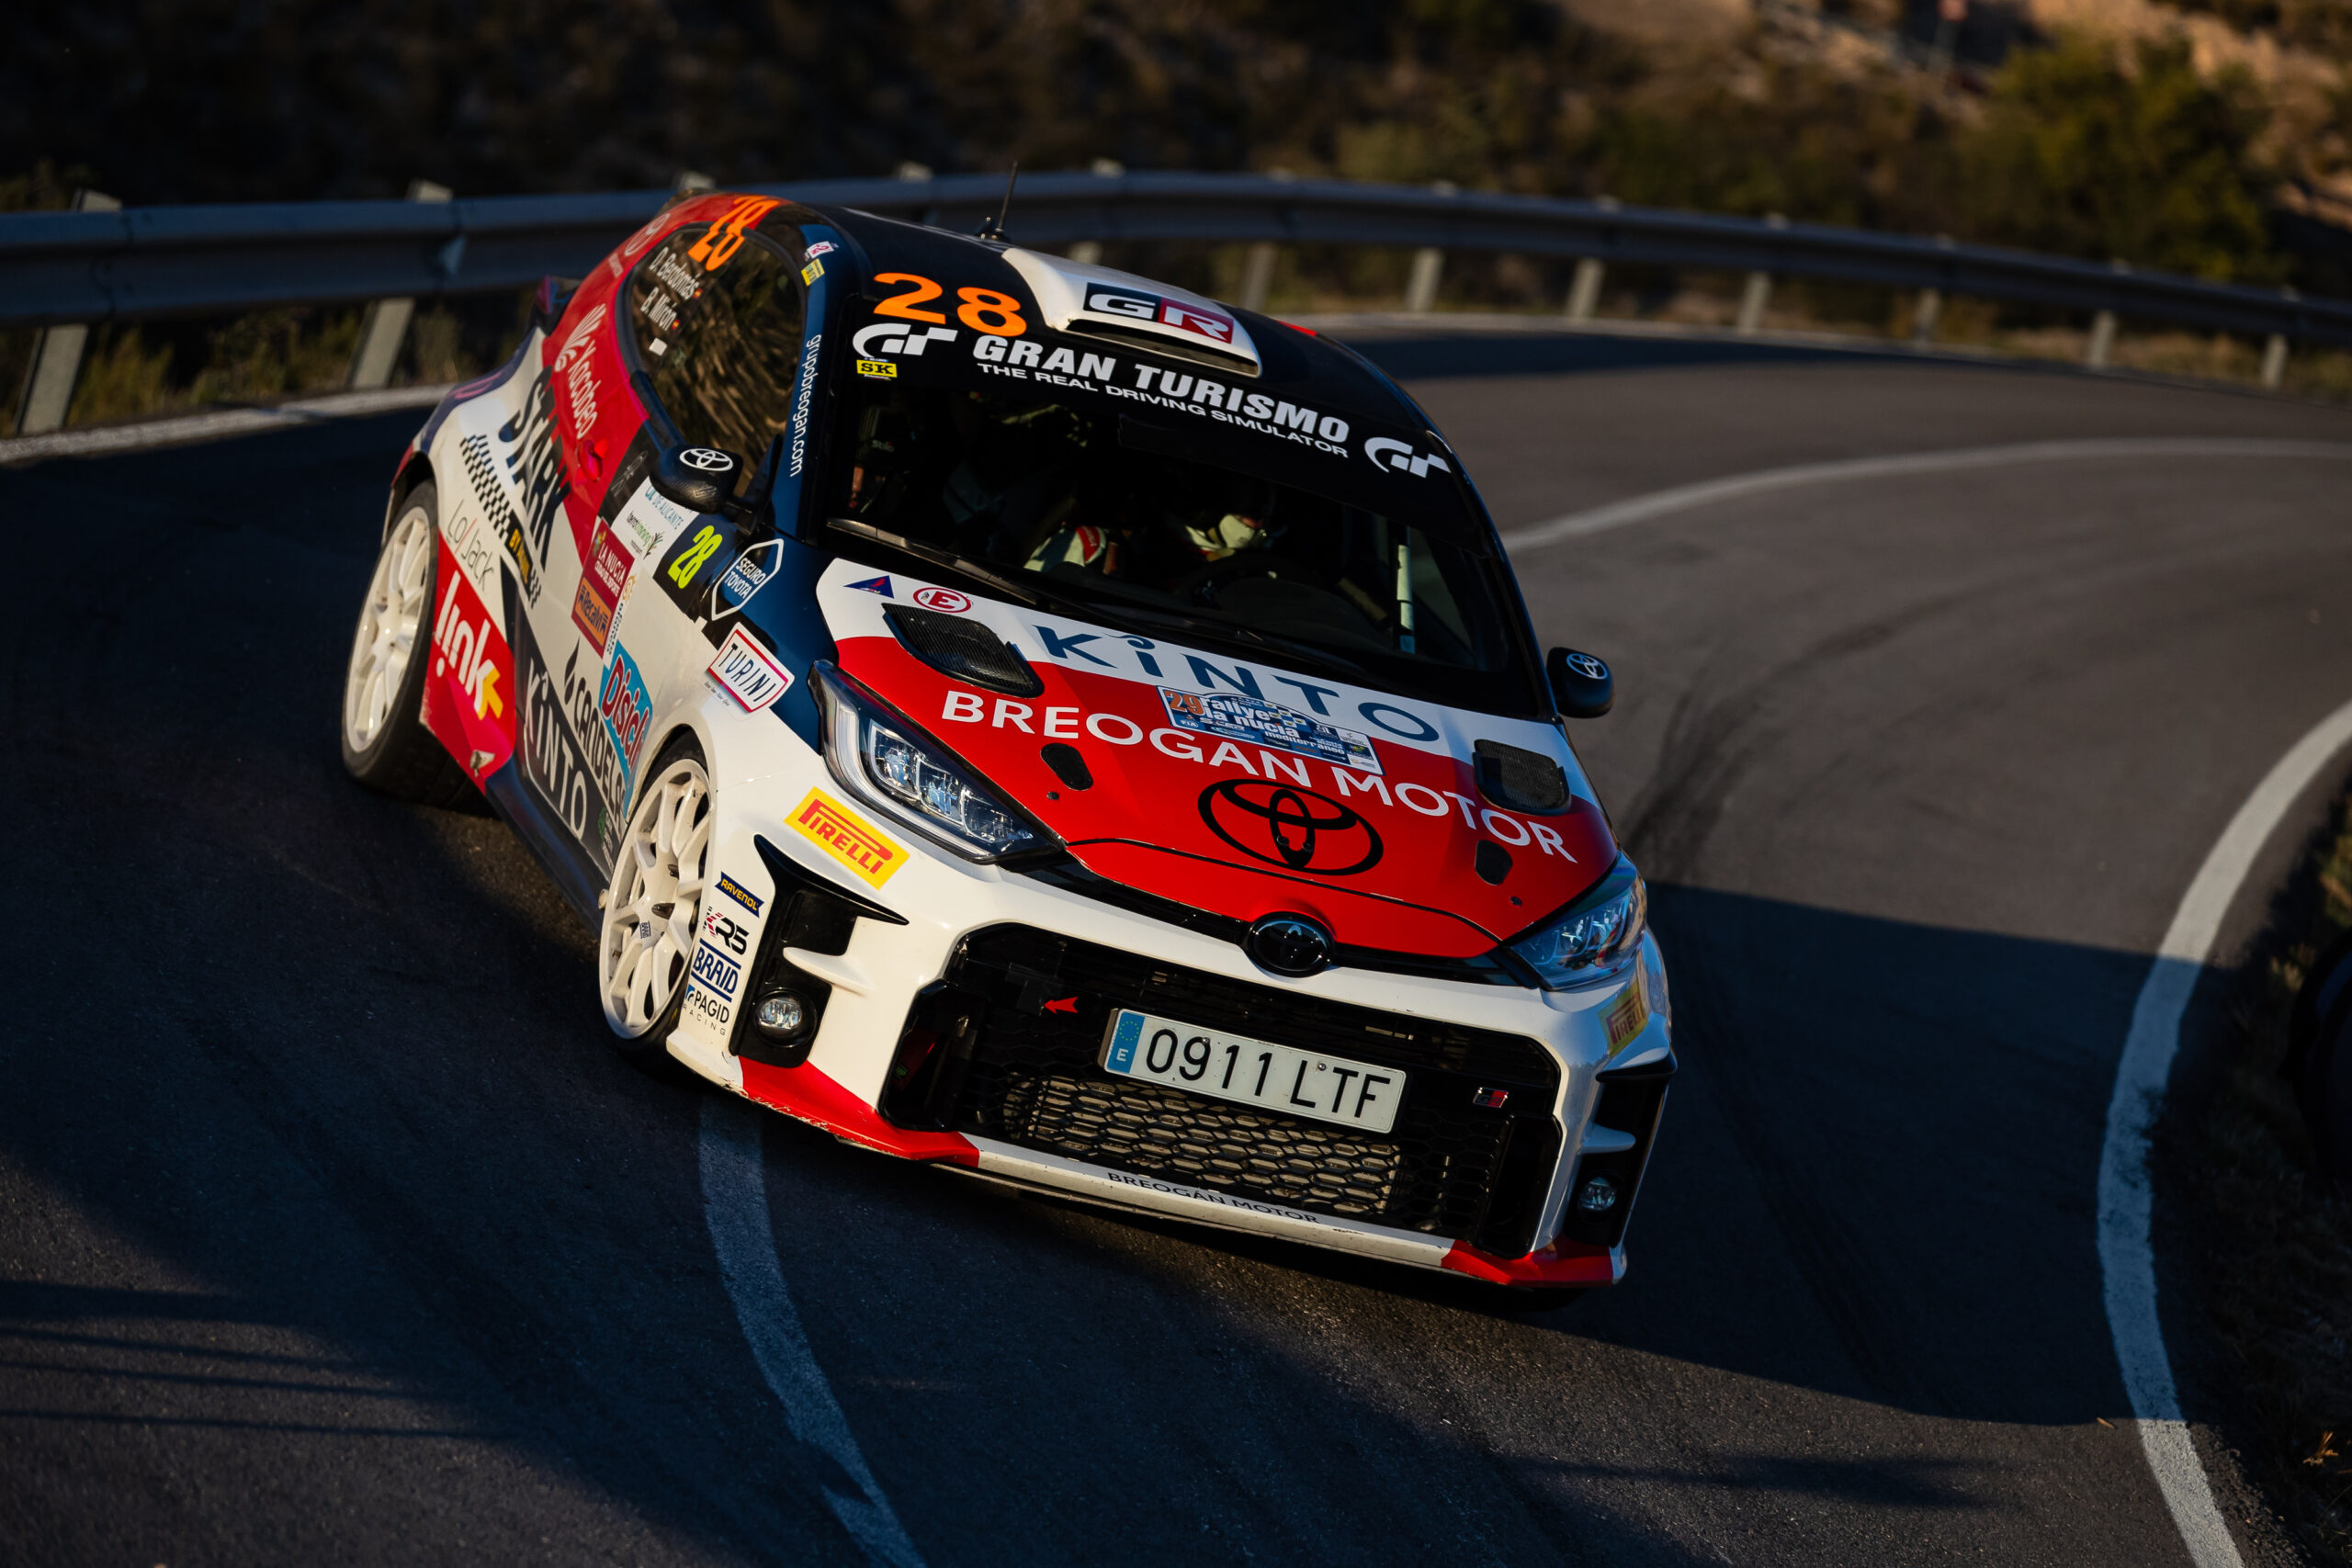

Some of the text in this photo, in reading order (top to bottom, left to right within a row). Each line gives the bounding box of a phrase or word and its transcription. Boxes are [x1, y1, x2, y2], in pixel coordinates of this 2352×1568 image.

[687, 195, 780, 272] 28
[873, 272, 1027, 337] 28
[1088, 292, 1234, 344] GR
[853, 322, 958, 357] GT
[568, 339, 602, 440] Xacobeo
[861, 362, 893, 375] SK
[973, 334, 1351, 444] GRAN TURISMO
[790, 333, 822, 478] grupobreogan.com
[978, 363, 1350, 459] THE REAL DRIVING SIMULATOR
[498, 364, 571, 573] STARK
[668, 525, 723, 589] 28
[735, 558, 766, 585] SEGURO
[724, 570, 752, 599] TOYOTA
[928, 591, 960, 610] E
[718, 642, 777, 703] TURINI
[1164, 691, 1205, 716] 29
[1201, 697, 1271, 720] rallye
[1204, 706, 1229, 722] la
[941, 690, 1578, 864] BREOGAN MOTOR
[797, 798, 893, 874] PIRELLI
[720, 877, 759, 911] RAVENOL
[693, 947, 739, 995] BRAID
[683, 1002, 727, 1036] RACING
[694, 989, 729, 1024] PAGID
[1115, 1048, 1129, 1063] E
[1146, 1028, 1391, 1119] 0911 LTF
[1231, 1199, 1321, 1224] MOTOR
